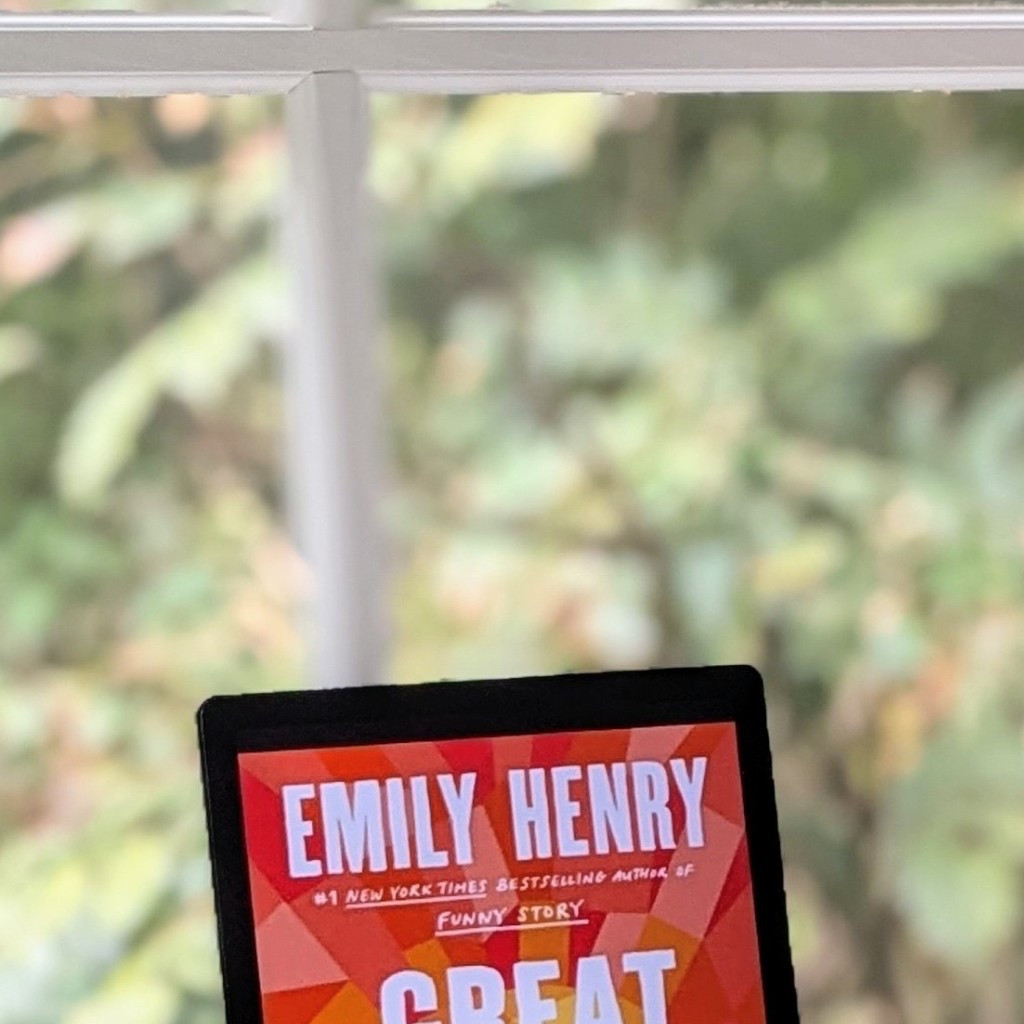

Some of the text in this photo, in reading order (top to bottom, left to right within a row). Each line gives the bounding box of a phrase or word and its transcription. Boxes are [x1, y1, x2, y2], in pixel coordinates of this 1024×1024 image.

[282, 756, 708, 879] EMILY HENRY
[314, 863, 696, 906] #1 NEW YORK TIMES BESTSELLING AUTHOR OF
[436, 900, 585, 931] FUNNY STORY
